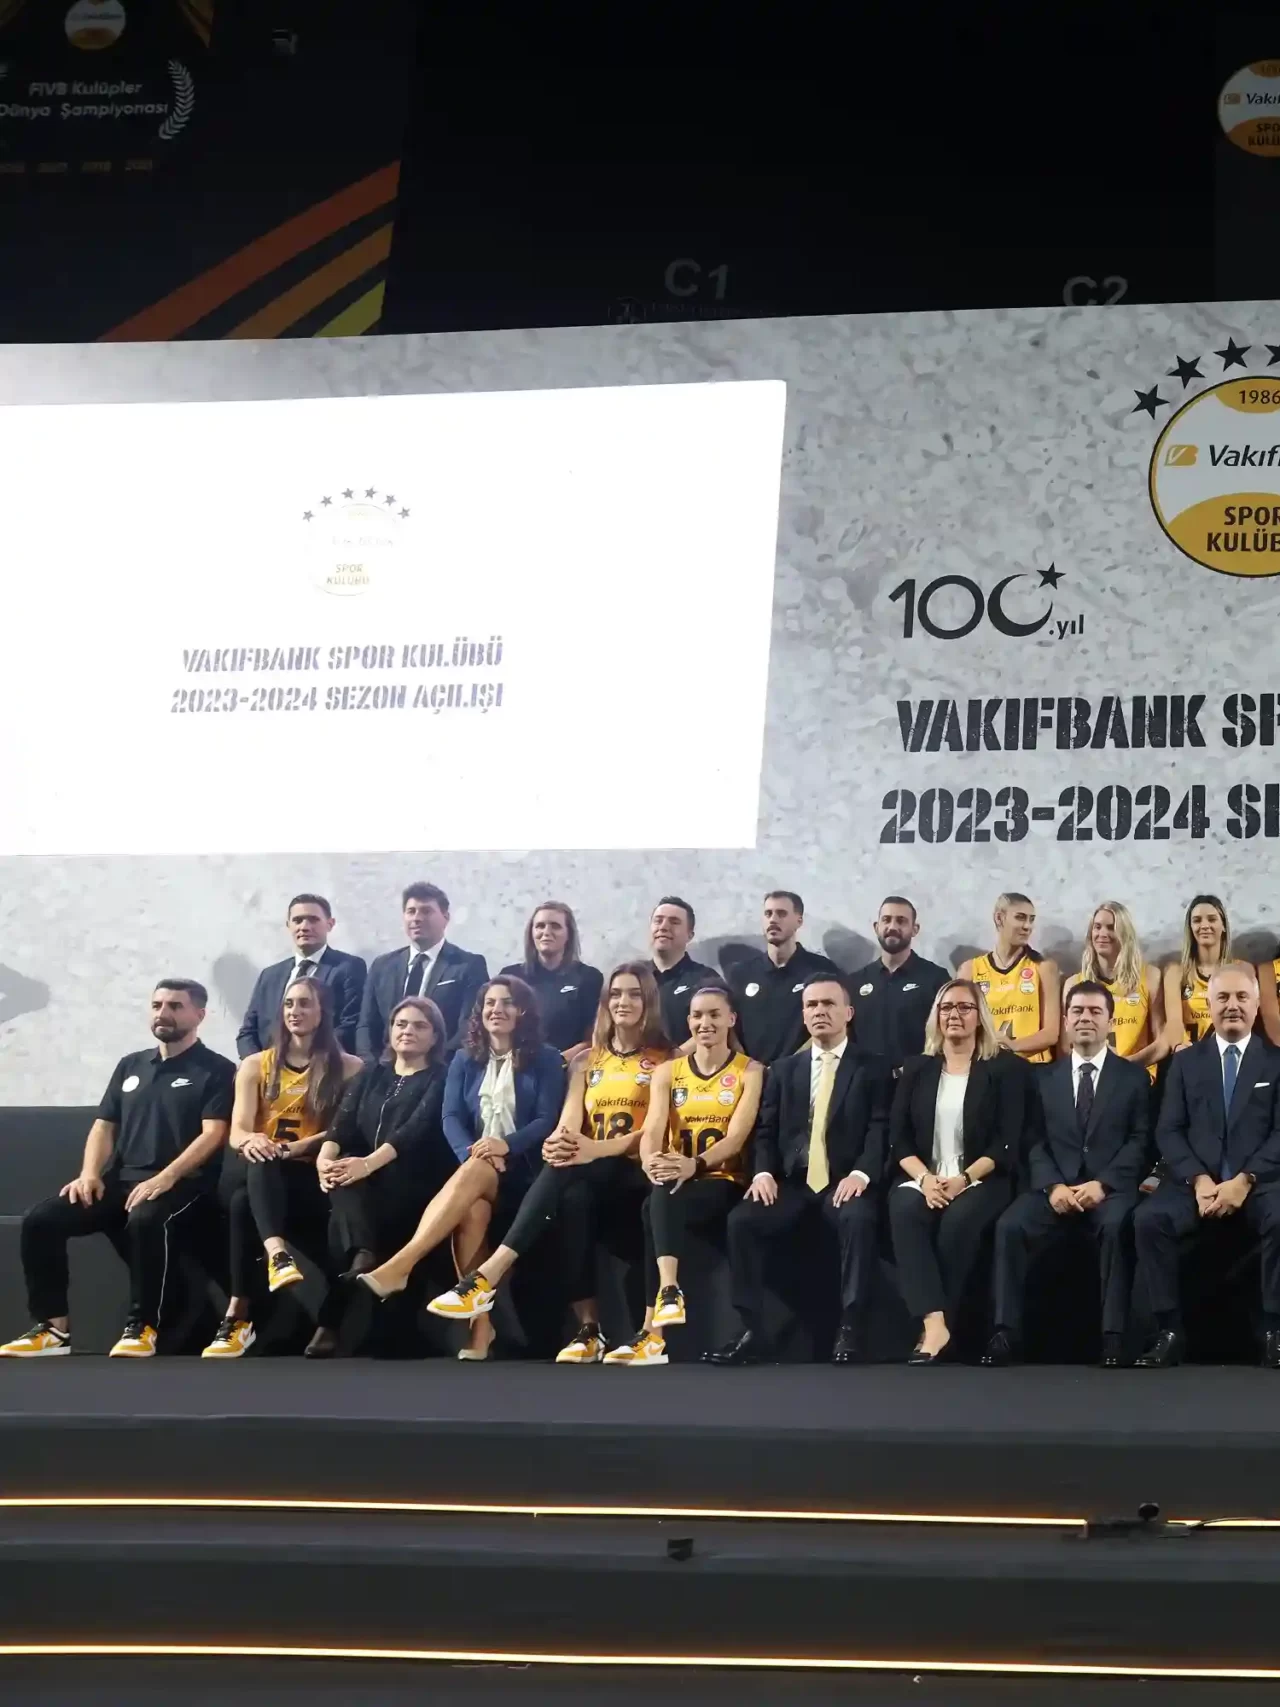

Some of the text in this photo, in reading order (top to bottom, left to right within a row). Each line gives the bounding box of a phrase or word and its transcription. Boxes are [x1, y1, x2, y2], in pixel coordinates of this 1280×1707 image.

[28, 80, 143, 98] FIVB Kulüpler
[60, 101, 168, 119] Şampiyonası
[664, 257, 729, 300] C1
[1062, 275, 1129, 306] C2
[183, 635, 503, 673] VAKIFBANK SPOR KULÜBÜ
[171, 682, 504, 715] 2023-2024 SEZON AÇILIŞI
[897, 694, 1207, 753] VAKIFBANK
[880, 785, 1211, 844] 2023-2024
[274, 1118, 300, 1142] 5
[593, 1111, 634, 1140] 18
[680, 1128, 726, 1158] 10
